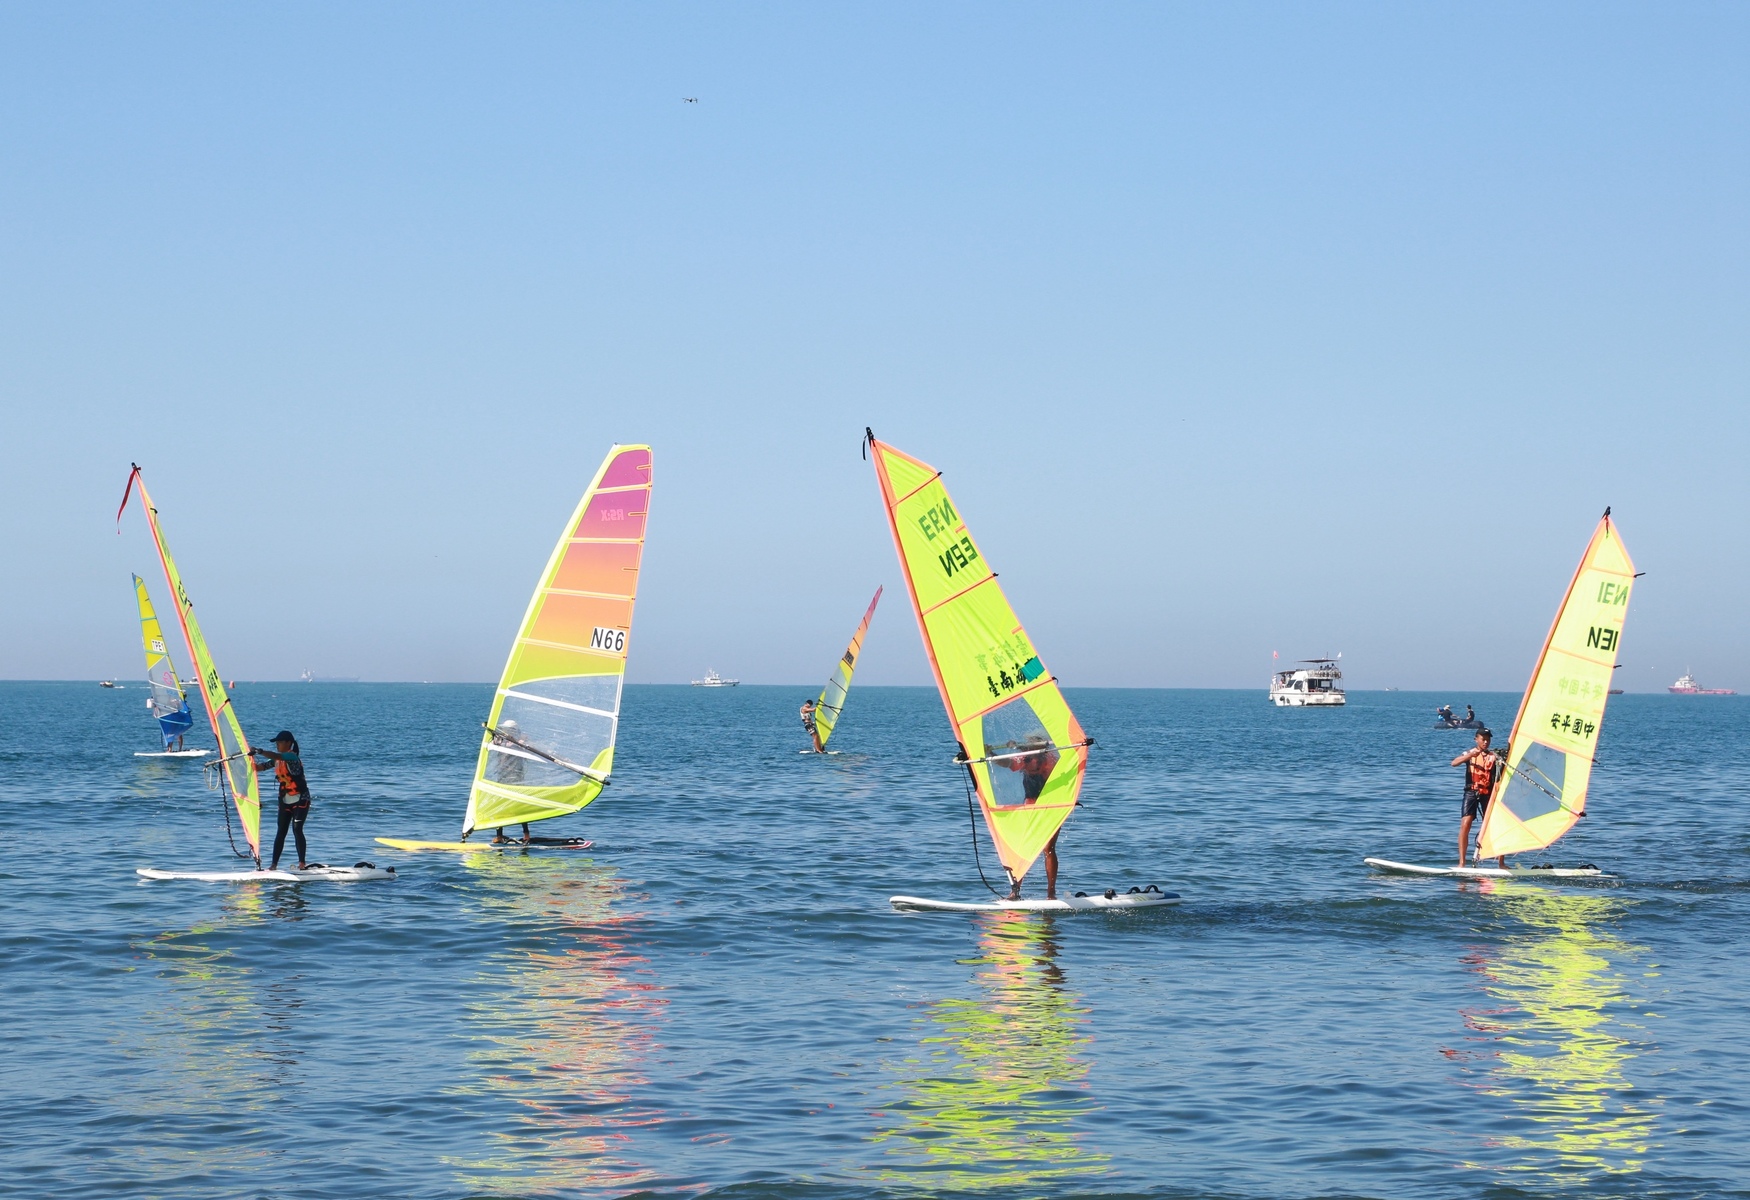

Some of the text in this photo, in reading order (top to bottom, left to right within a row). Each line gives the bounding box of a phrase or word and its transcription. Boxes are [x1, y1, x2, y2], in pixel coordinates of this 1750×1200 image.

[590, 627, 625, 652] N66
[986, 657, 1038, 698] 臺南海
